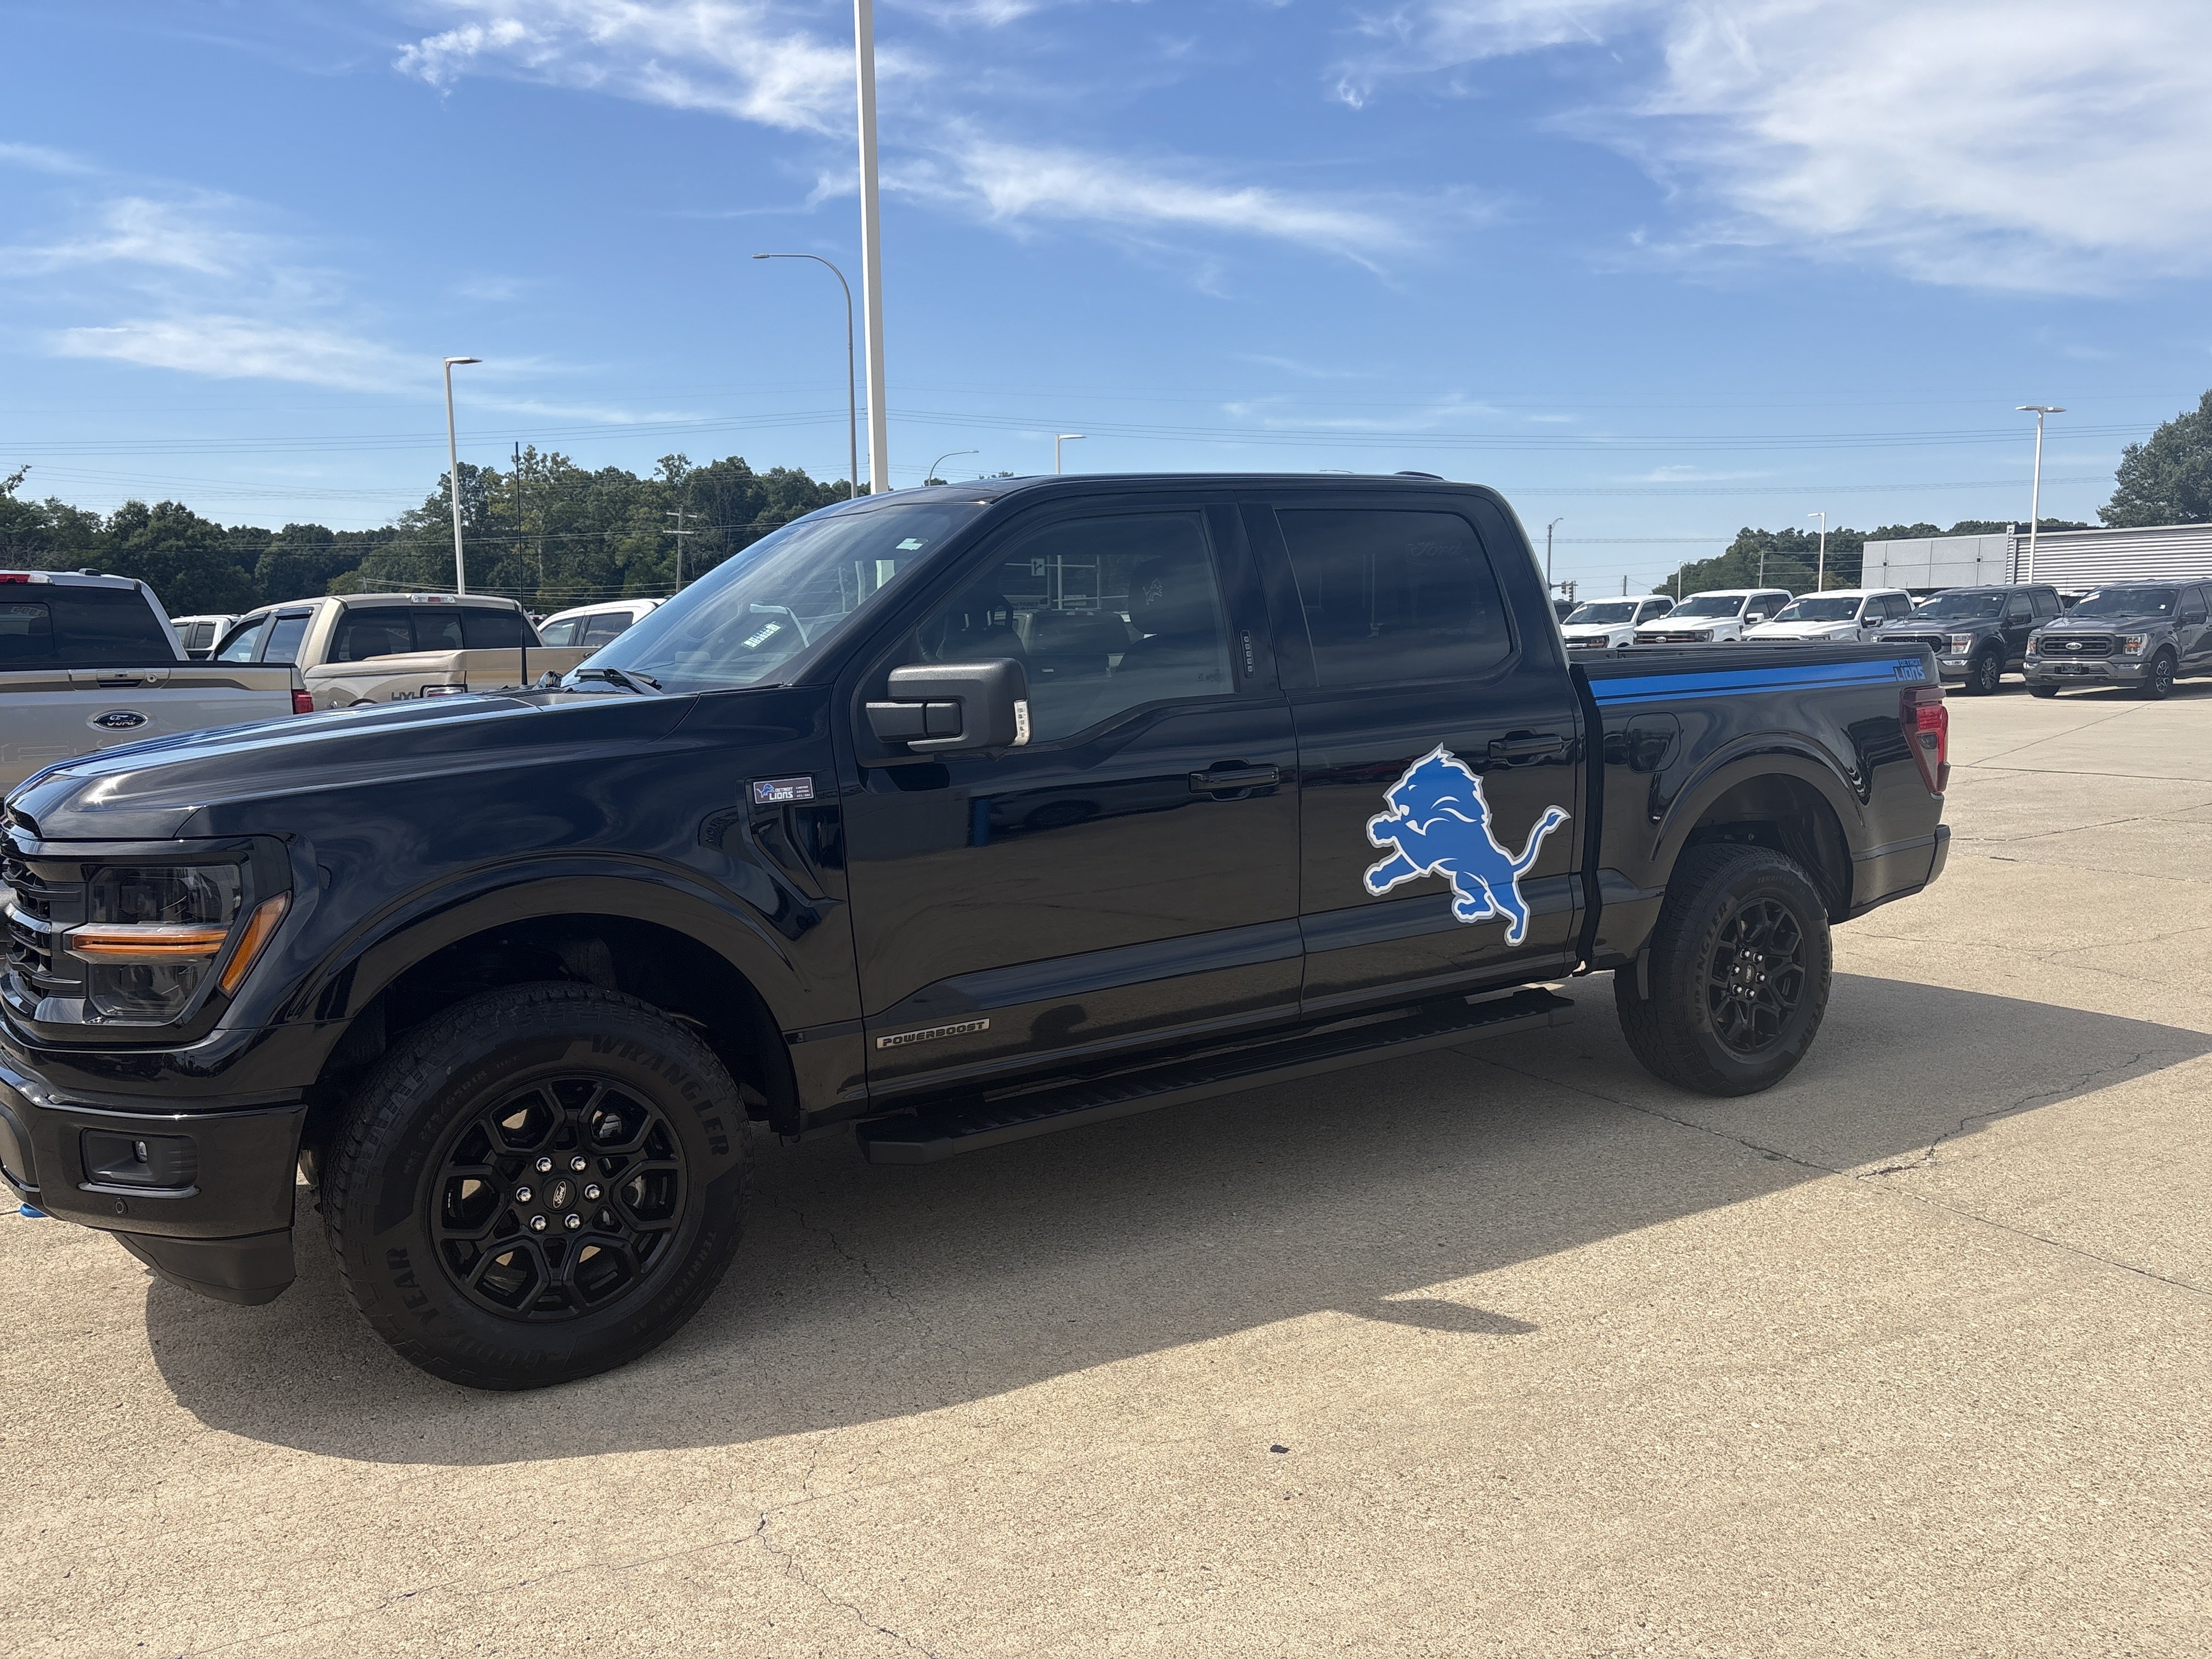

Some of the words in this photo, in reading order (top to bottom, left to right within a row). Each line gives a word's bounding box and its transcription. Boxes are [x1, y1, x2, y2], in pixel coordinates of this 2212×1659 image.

[1895, 666, 1926, 681] LIONS
[769, 791, 794, 800] LIONS
[1694, 901, 1728, 1025] WRANGLER
[882, 1021, 985, 1047] POWERBOOST
[591, 1034, 730, 1156] WRANGLER
